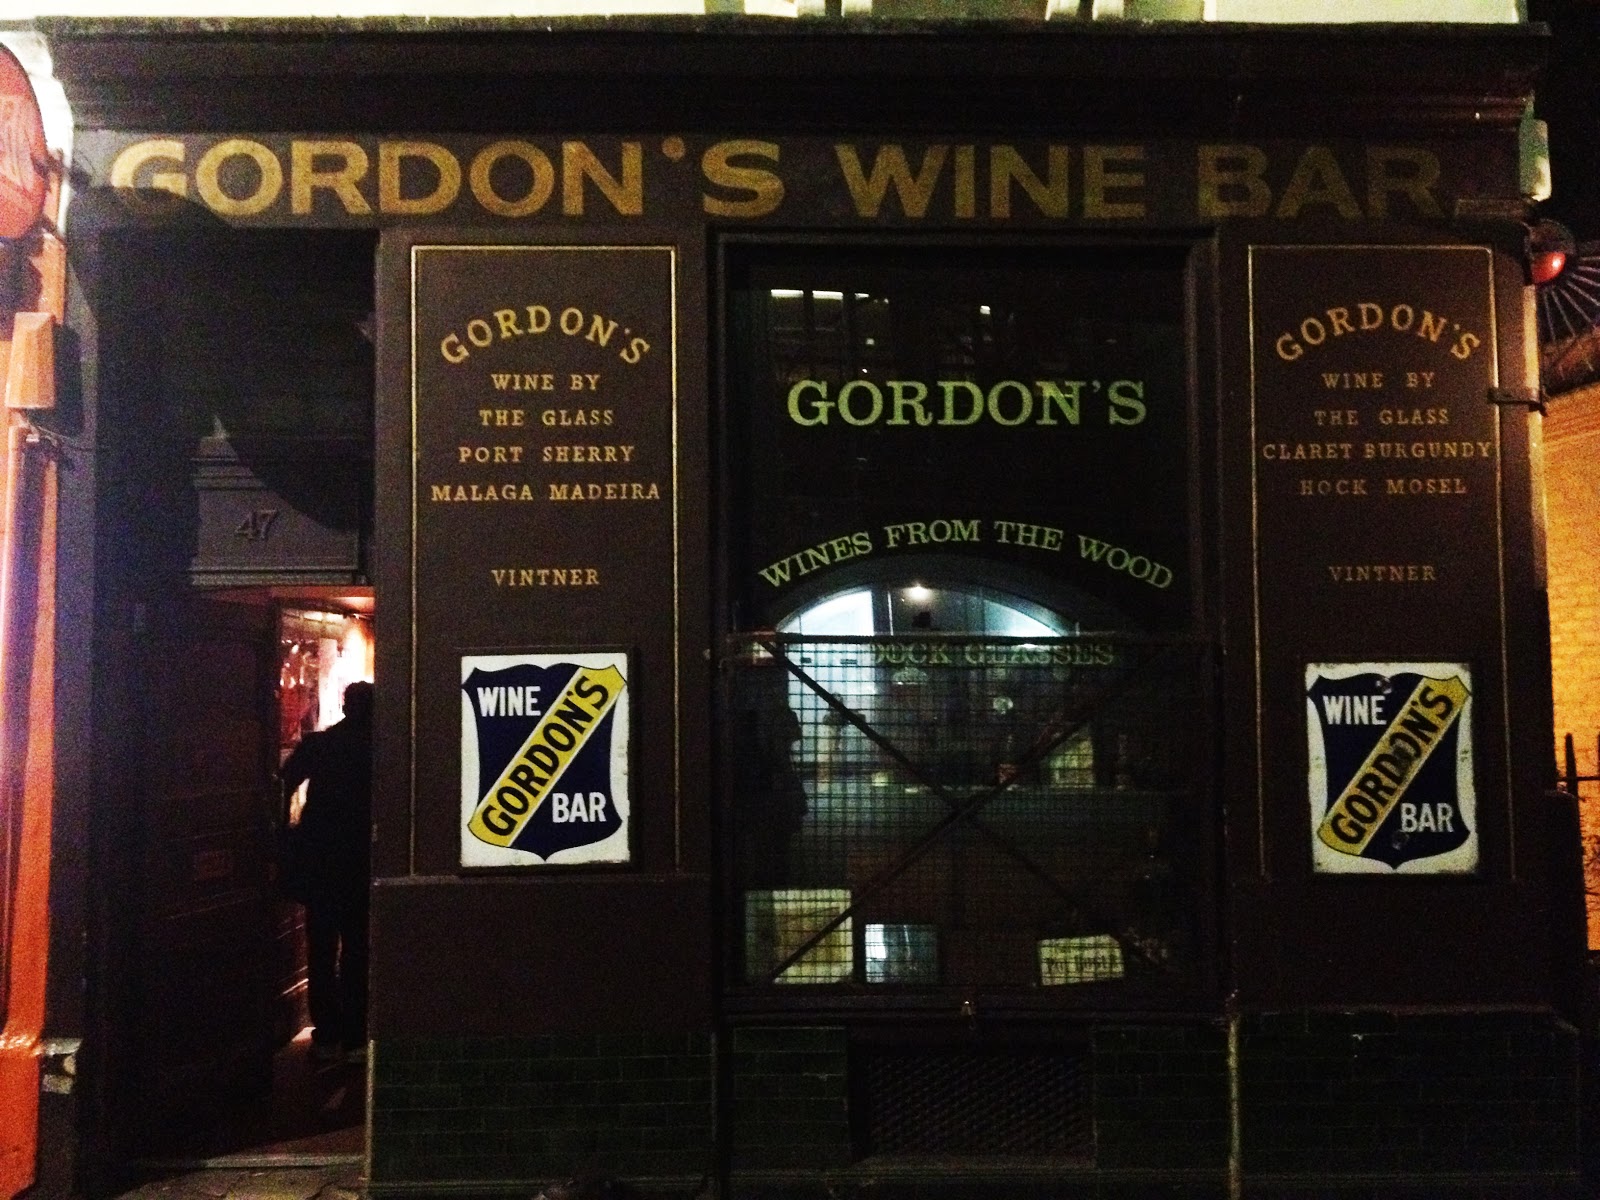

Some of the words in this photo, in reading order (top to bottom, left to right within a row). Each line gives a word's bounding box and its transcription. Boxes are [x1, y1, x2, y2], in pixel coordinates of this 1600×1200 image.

[109, 137, 787, 219] GORDON'S
[833, 142, 1147, 221] WINE
[1197, 142, 1444, 221] BAR
[440, 304, 651, 365] GORDON'S
[1275, 302, 1481, 362] GORDON'S
[491, 373, 555, 391] WINE
[570, 373, 601, 391] BY
[1321, 372, 1384, 389] WINE
[1406, 371, 1435, 388] BY
[479, 409, 525, 426] THE
[541, 409, 614, 426] GLASS
[786, 378, 1148, 428] GORDON'S
[1314, 409, 1360, 426] THE
[1378, 408, 1449, 425] GLASS
[458, 446, 523, 463] PORT
[542, 445, 635, 462] SHERRY
[1262, 443, 1353, 460] CLARET
[1363, 442, 1492, 459] BURGUNDY
[431, 484, 534, 502] MALAGA
[549, 482, 661, 500] MADEIRA
[1299, 479, 1368, 496] HOCK
[1385, 478, 1467, 495] MOSEL
[234, 508, 280, 542] 47
[757, 531, 874, 589] WINES
[883, 519, 982, 550] FROM
[993, 520, 1064, 551] THE
[1076, 534, 1174, 590] WOOD
[491, 568, 600, 587] VINTNER
[1328, 565, 1437, 583] VINTNER
[477, 686, 542, 717] WINE
[1322, 695, 1387, 726] WINE
[481, 675, 610, 837] GORDON'S
[551, 791, 607, 824] BAR
[1400, 802, 1455, 834] BAR
